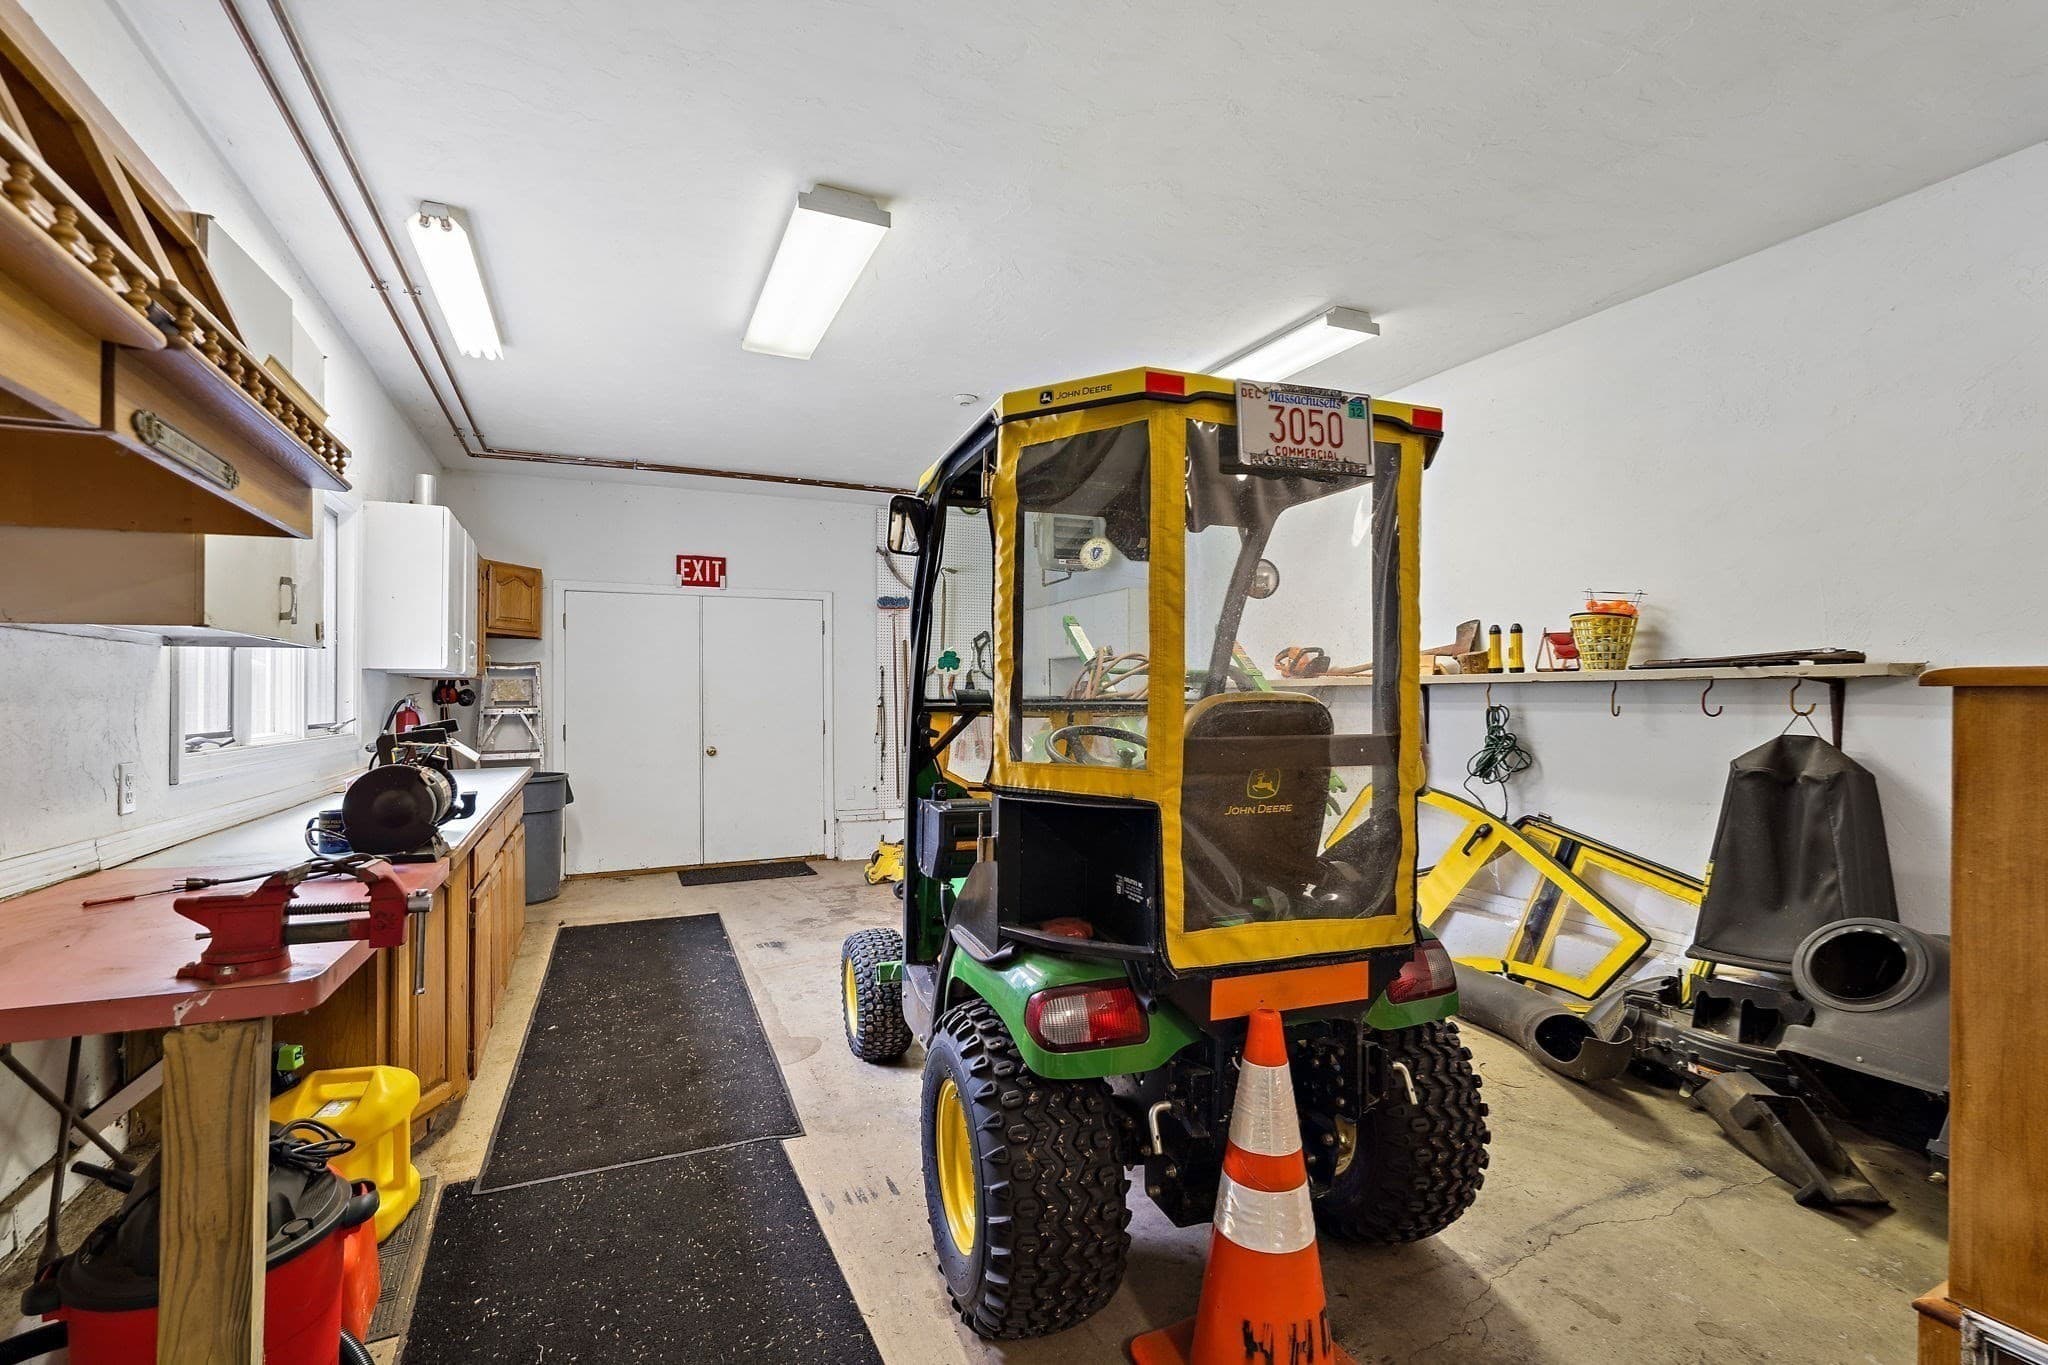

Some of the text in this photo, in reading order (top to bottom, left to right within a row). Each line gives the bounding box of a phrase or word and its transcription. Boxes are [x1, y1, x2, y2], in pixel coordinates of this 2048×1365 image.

[1056, 384, 1113, 400] JOHN DEERE
[1241, 387, 1262, 399] DEC
[1267, 390, 1342, 410] Massachusetts
[1268, 404, 1344, 449] 3050
[1274, 445, 1339, 461] COMMERCIAL
[680, 559, 722, 583] EXIT
[1224, 803, 1294, 816] JOHN DEERE
